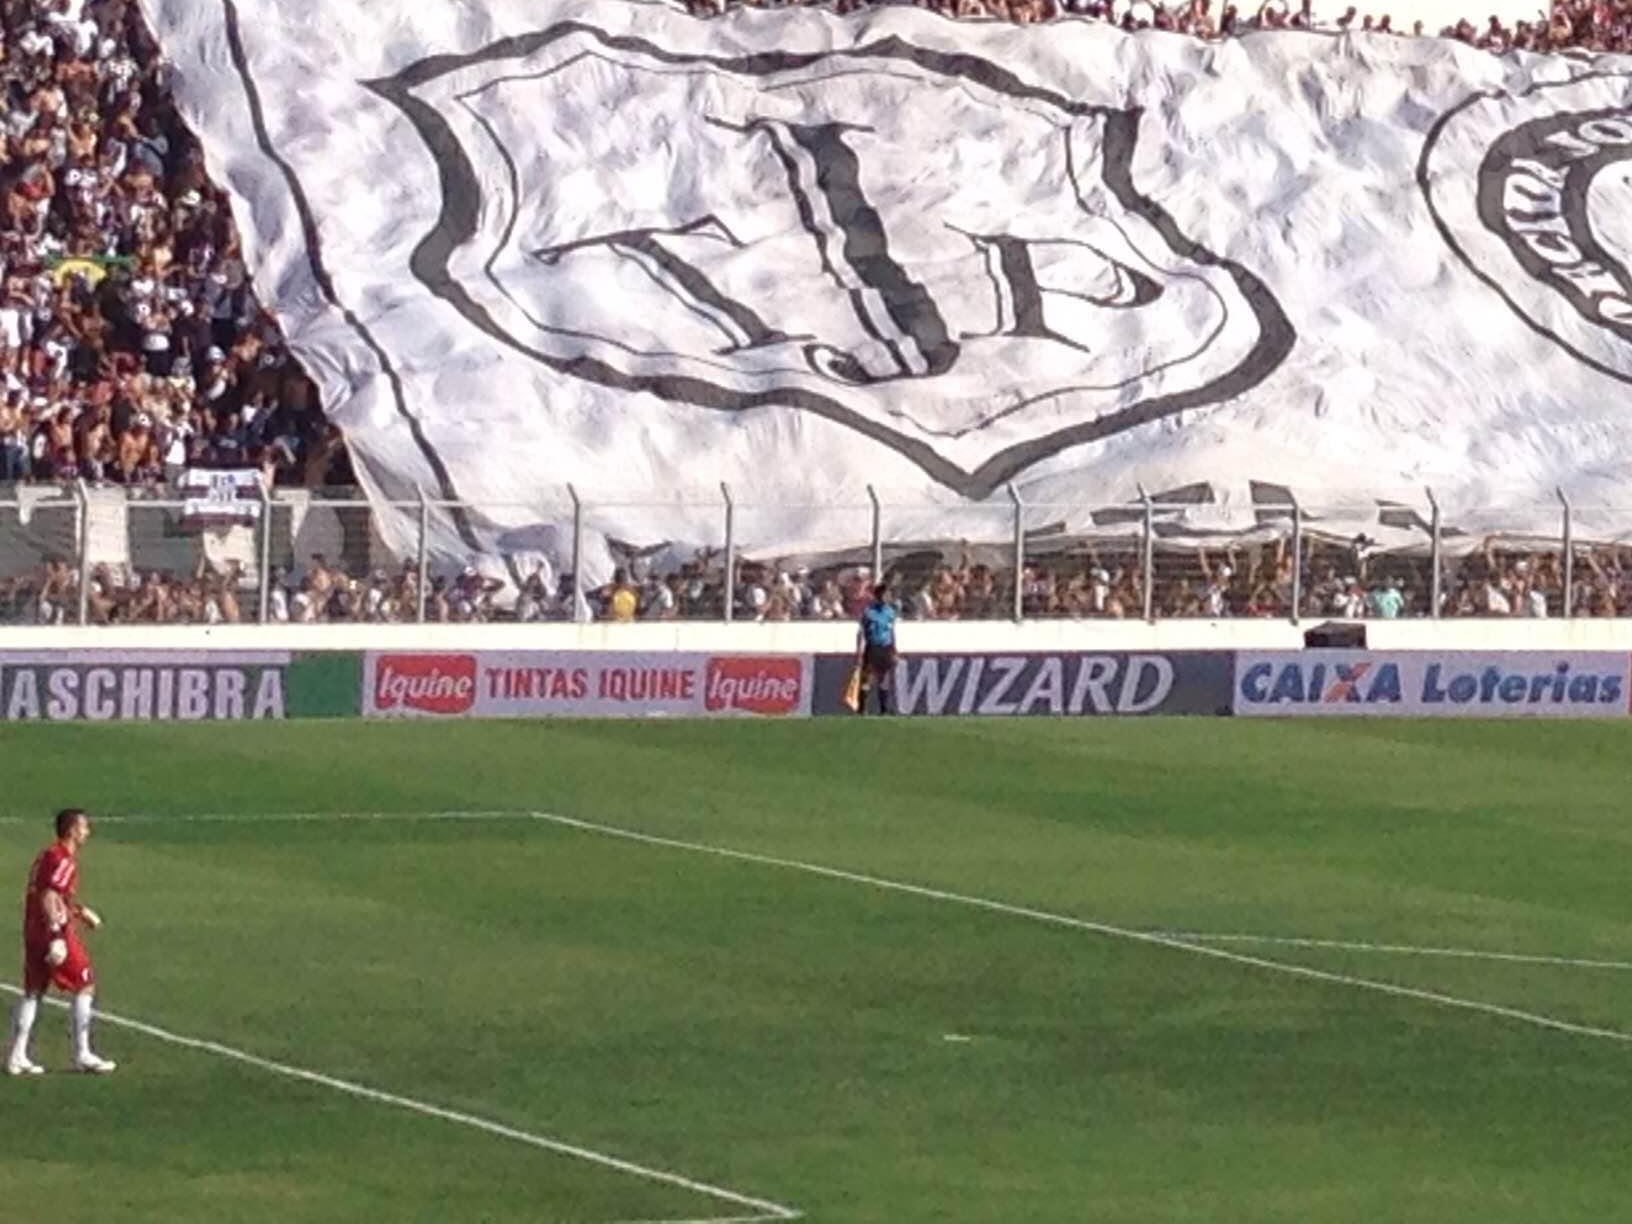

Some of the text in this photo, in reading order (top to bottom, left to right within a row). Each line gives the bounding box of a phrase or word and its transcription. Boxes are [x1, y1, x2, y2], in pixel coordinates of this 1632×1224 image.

[6, 668, 287, 720] ASCHIBRA
[485, 667, 696, 702] TINTAS IQUINE
[895, 655, 1175, 714] WIZARD
[1239, 660, 1621, 705] CAIXA Loterias
